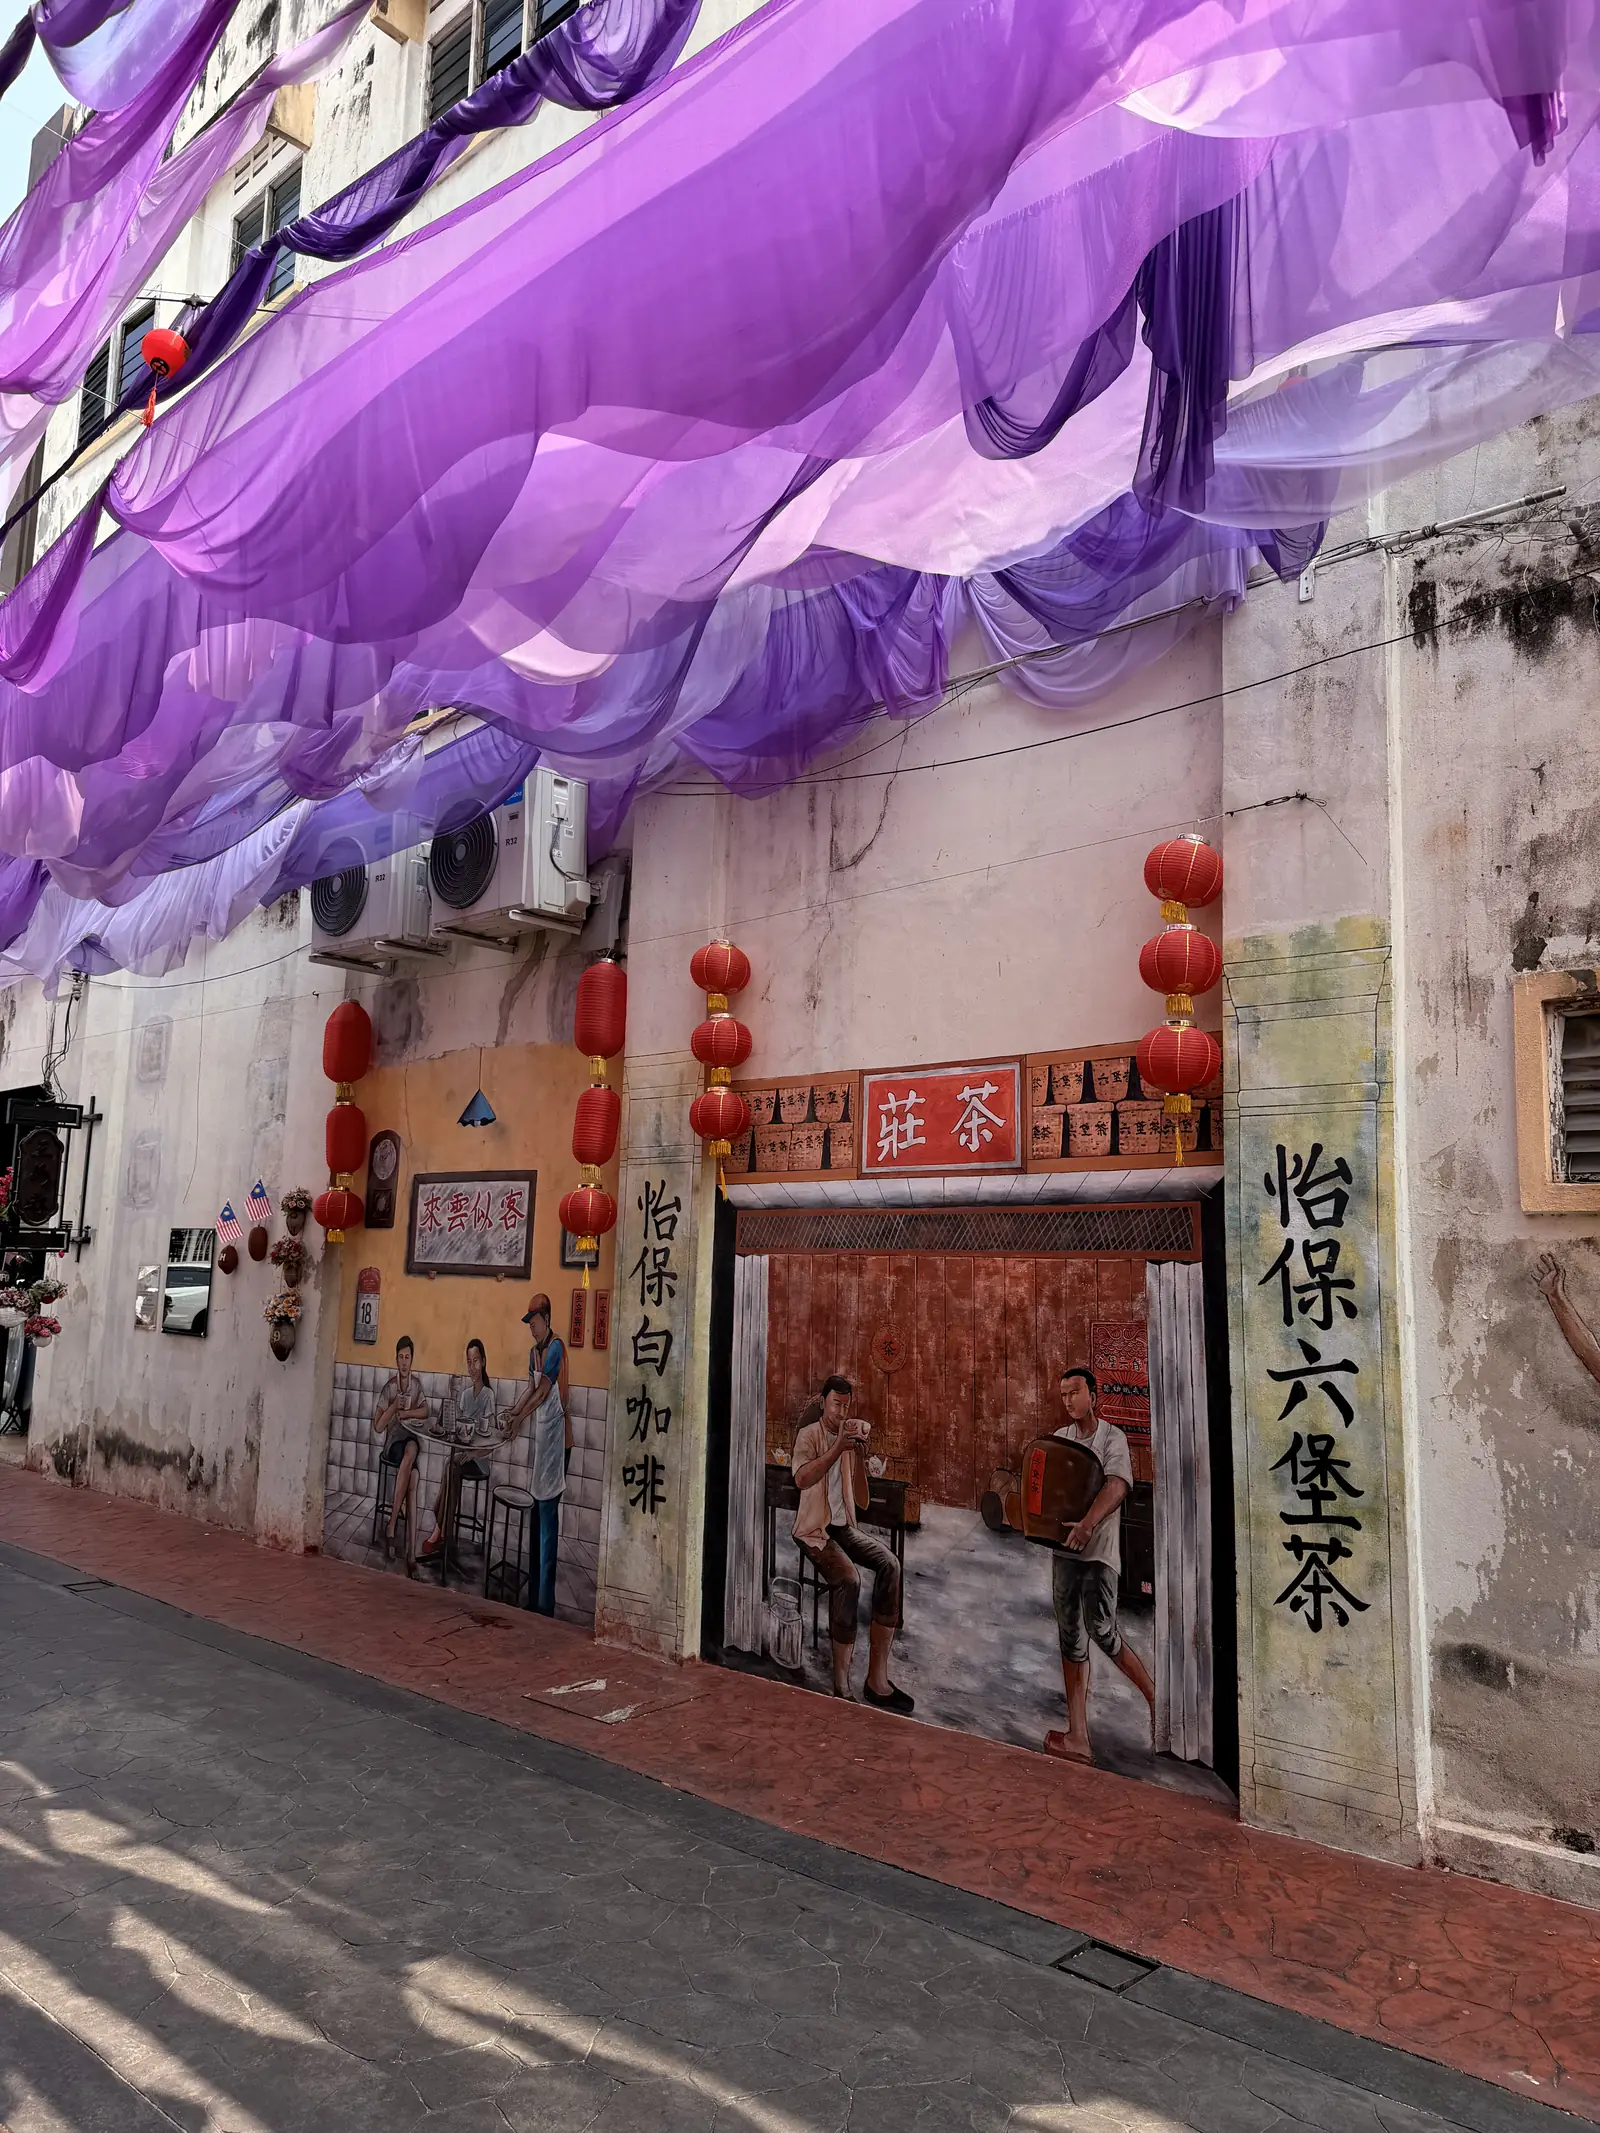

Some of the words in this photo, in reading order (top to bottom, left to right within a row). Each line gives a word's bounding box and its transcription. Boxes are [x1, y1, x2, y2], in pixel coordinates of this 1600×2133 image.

[505, 836, 518, 847] R32
[374, 873, 386, 883] R32
[361, 1302, 372, 1325] 18
[622, 1179, 682, 1516] 怡保白咖啡
[1257, 1142, 1371, 1633] 怡保六堡茶
